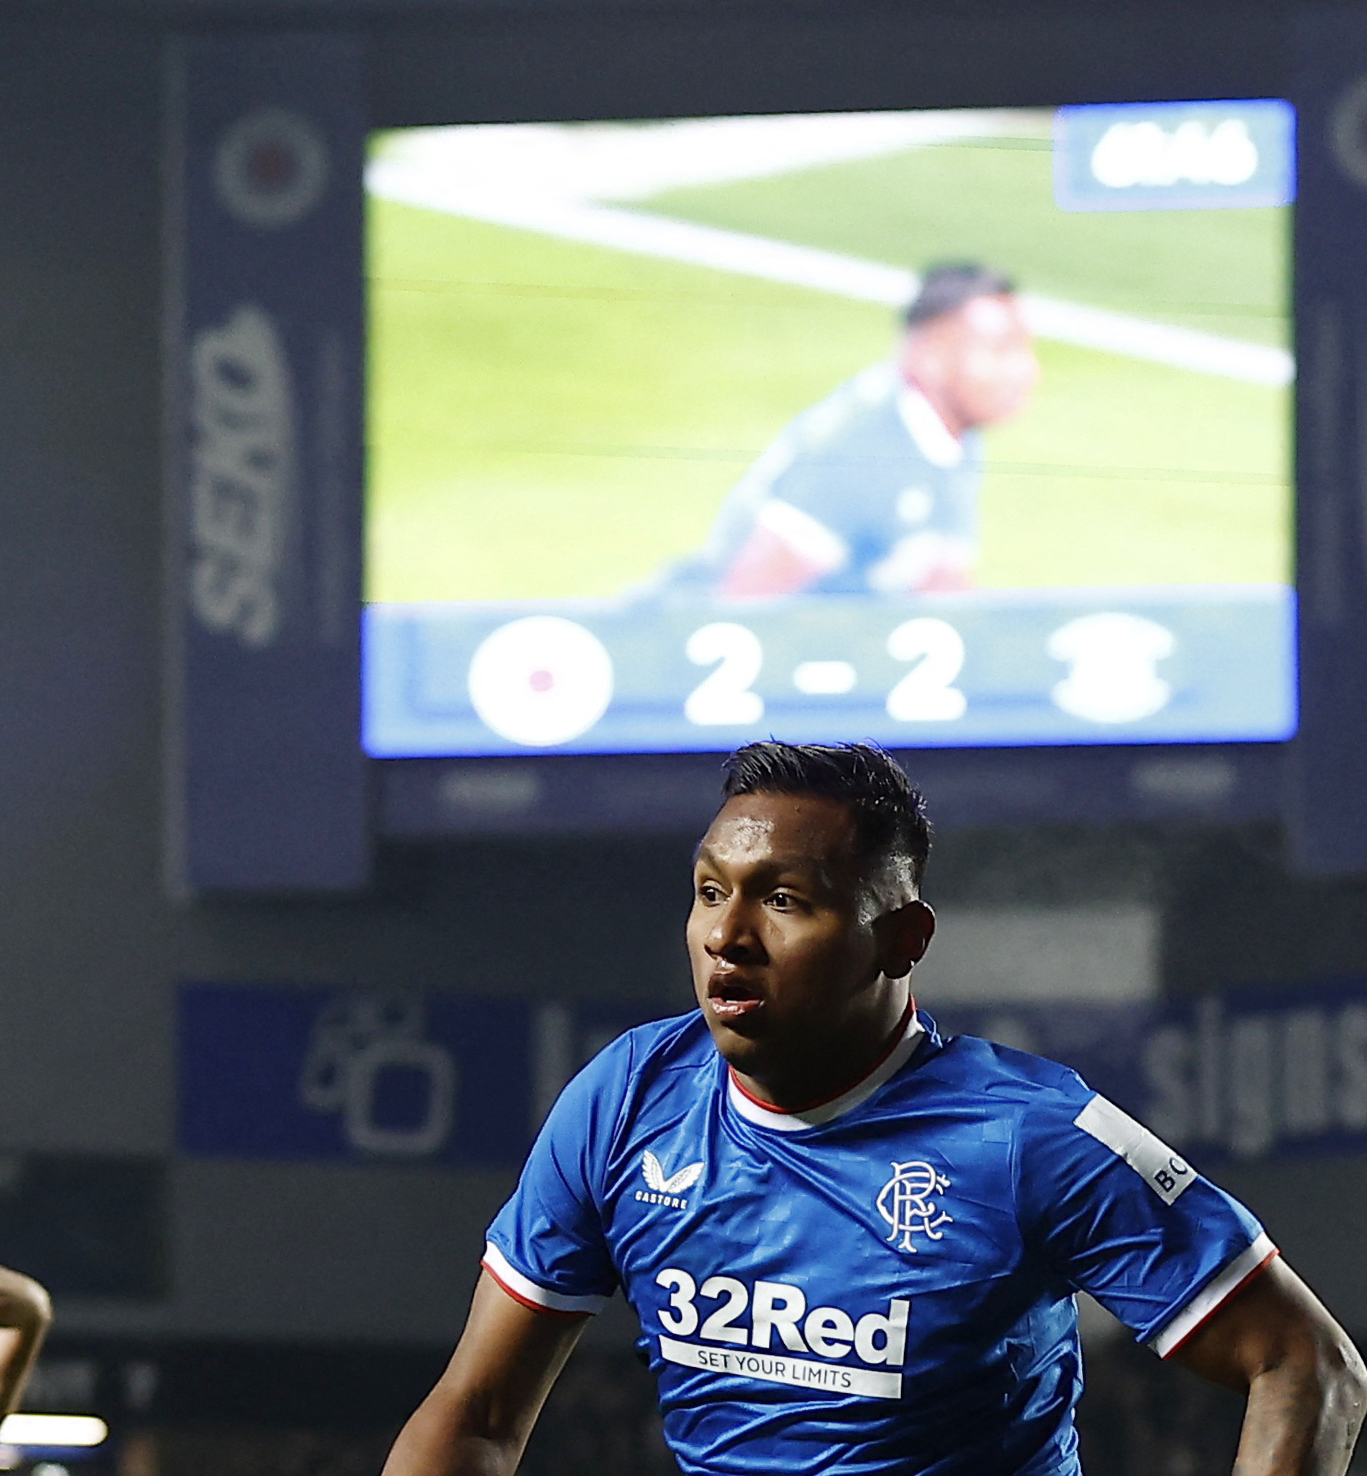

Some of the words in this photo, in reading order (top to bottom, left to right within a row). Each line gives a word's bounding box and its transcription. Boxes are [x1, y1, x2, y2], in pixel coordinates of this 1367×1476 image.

[685, 622, 765, 726] 2
[885, 617, 968, 721] 2
[635, 1190, 688, 1210] CASTORE
[655, 1268, 910, 1366] 32Red
[698, 1350, 730, 1369] SET
[735, 1354, 786, 1378] YOUR
[792, 1364, 852, 1388] LIMITS
